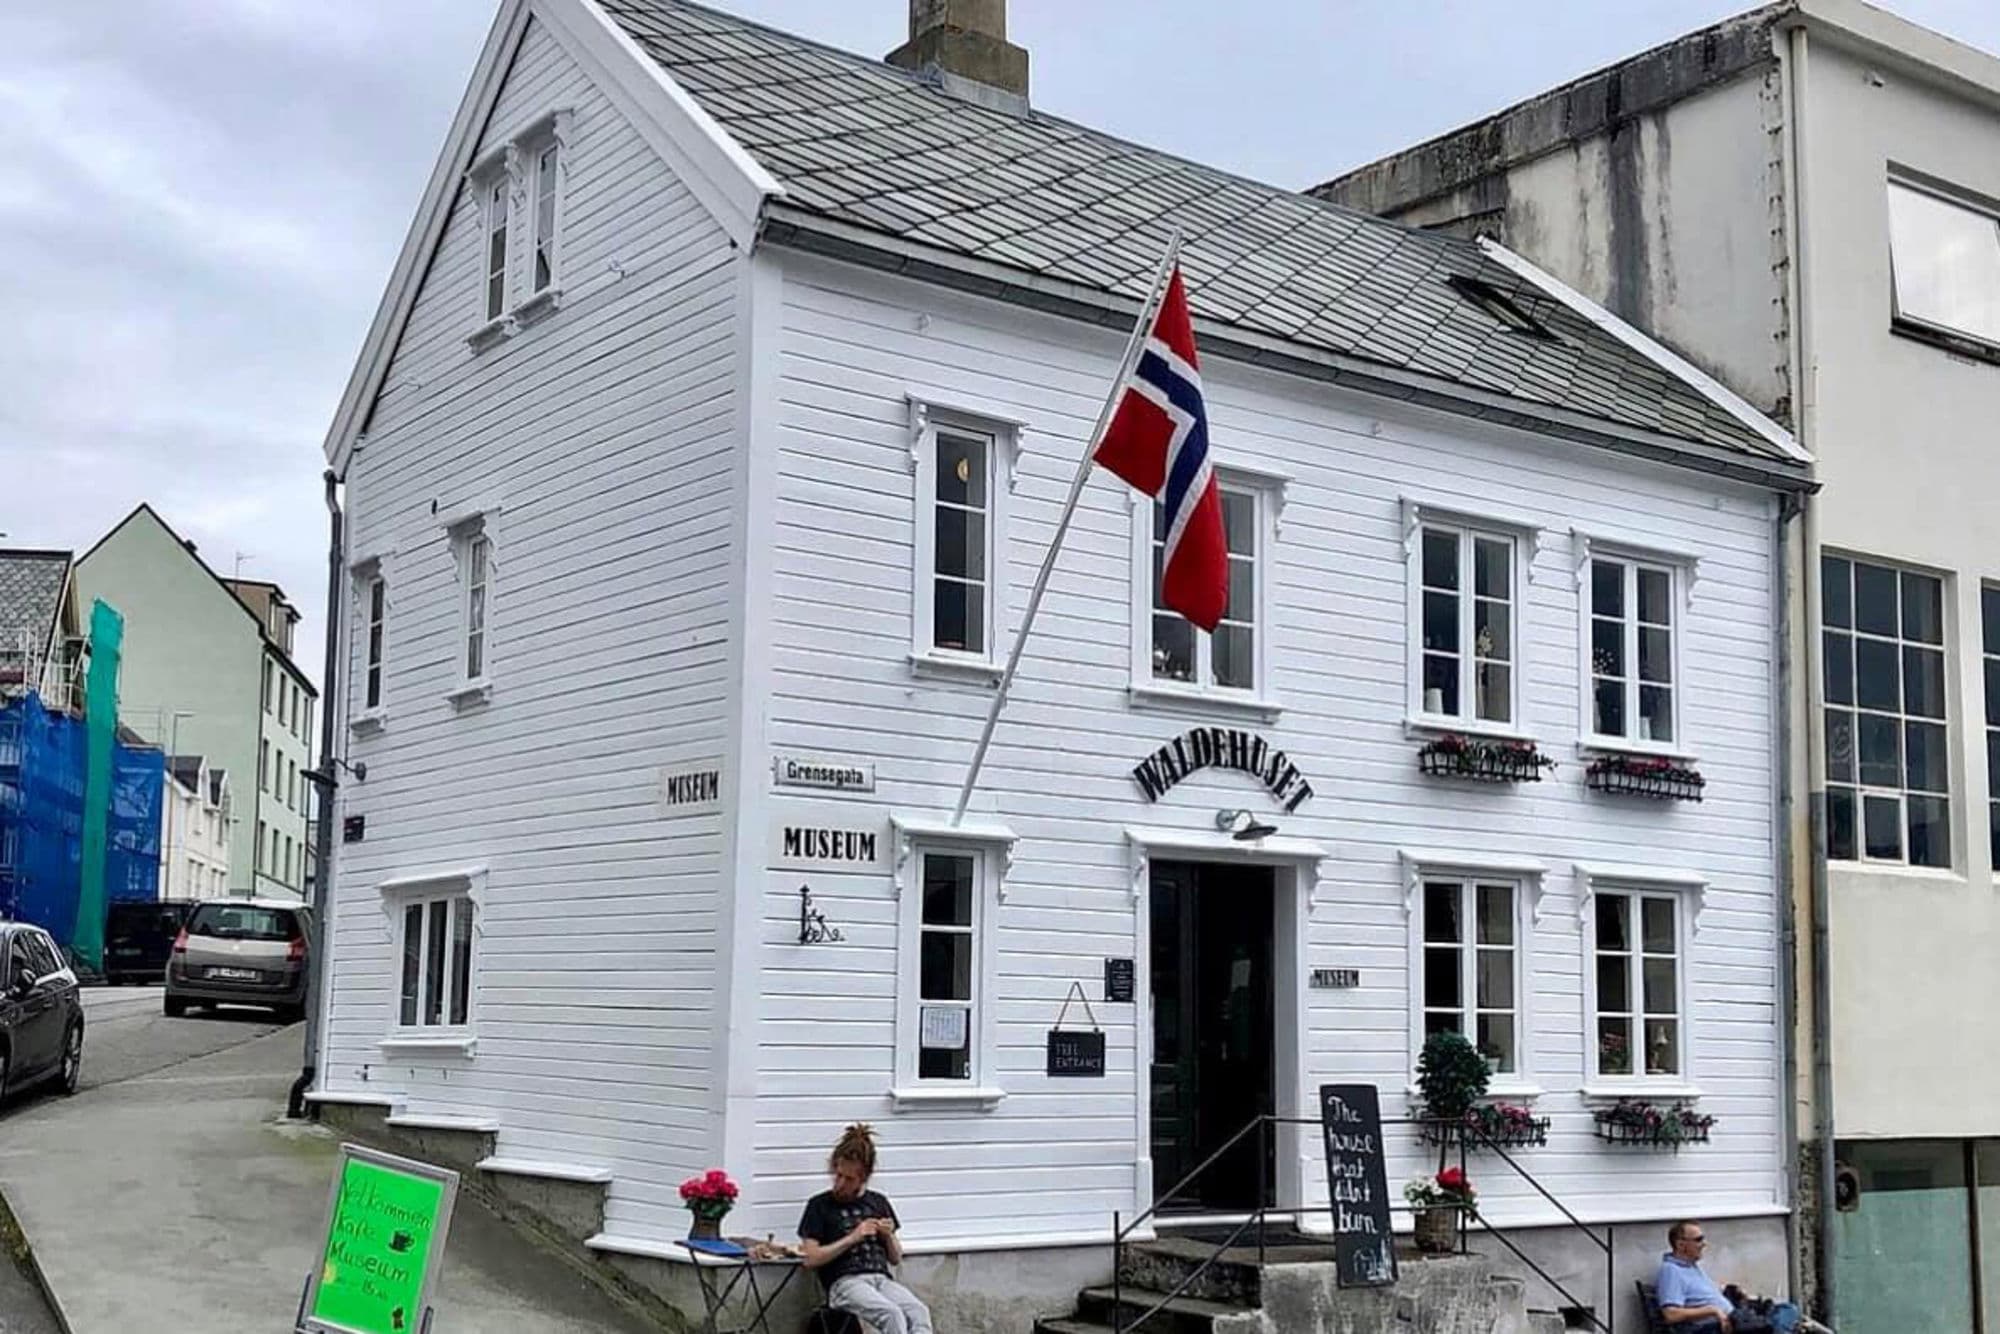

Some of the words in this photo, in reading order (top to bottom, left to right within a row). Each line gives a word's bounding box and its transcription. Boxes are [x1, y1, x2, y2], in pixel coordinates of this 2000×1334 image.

[787, 761, 864, 786] Grensegata
[1133, 727, 1314, 813] WALDEHUSET
[667, 771, 719, 805] MUSEUM
[784, 827, 876, 862] MUSEUM
[1314, 969, 1359, 986] MUSEUM
[1328, 1096, 1363, 1122] The
[330, 1240, 409, 1283] Museum
